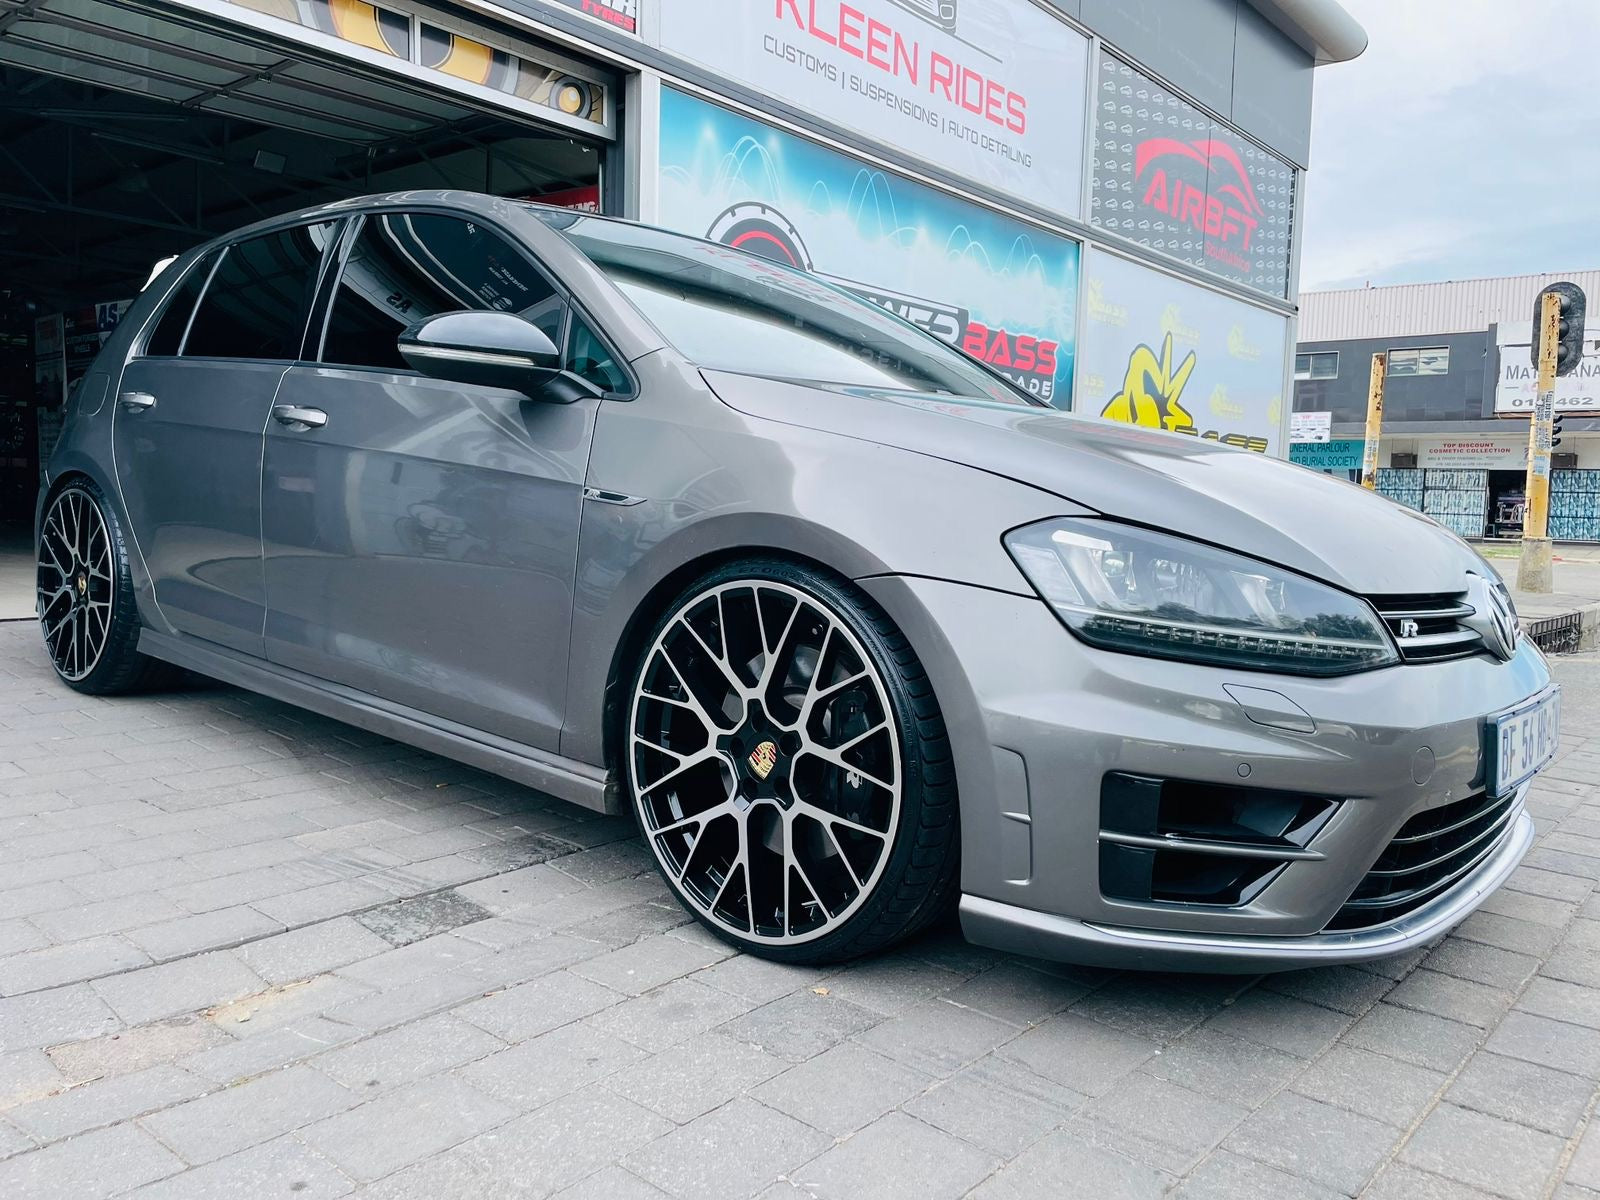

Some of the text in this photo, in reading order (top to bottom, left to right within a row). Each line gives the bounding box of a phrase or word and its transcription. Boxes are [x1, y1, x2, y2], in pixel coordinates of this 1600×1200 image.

[581, 0, 634, 33] TYRES
[763, 34, 838, 82] CUSTOMS
[849, 75, 939, 128] SUSPENSIONS
[948, 121, 978, 145] AUTO
[980, 132, 1032, 168] DETAILING
[929, 51, 1027, 136] RIDES
[1143, 168, 1258, 251] AIRBFT
[962, 321, 1059, 377] BASS
[1555, 396, 1594, 406] 462
[1302, 456, 1326, 466] BURIAL
[1327, 455, 1359, 467] SOCIETY
[1317, 442, 1350, 453] PARLOUR
[1401, 618, 1419, 638] R
[1521, 716, 1534, 770] 56
